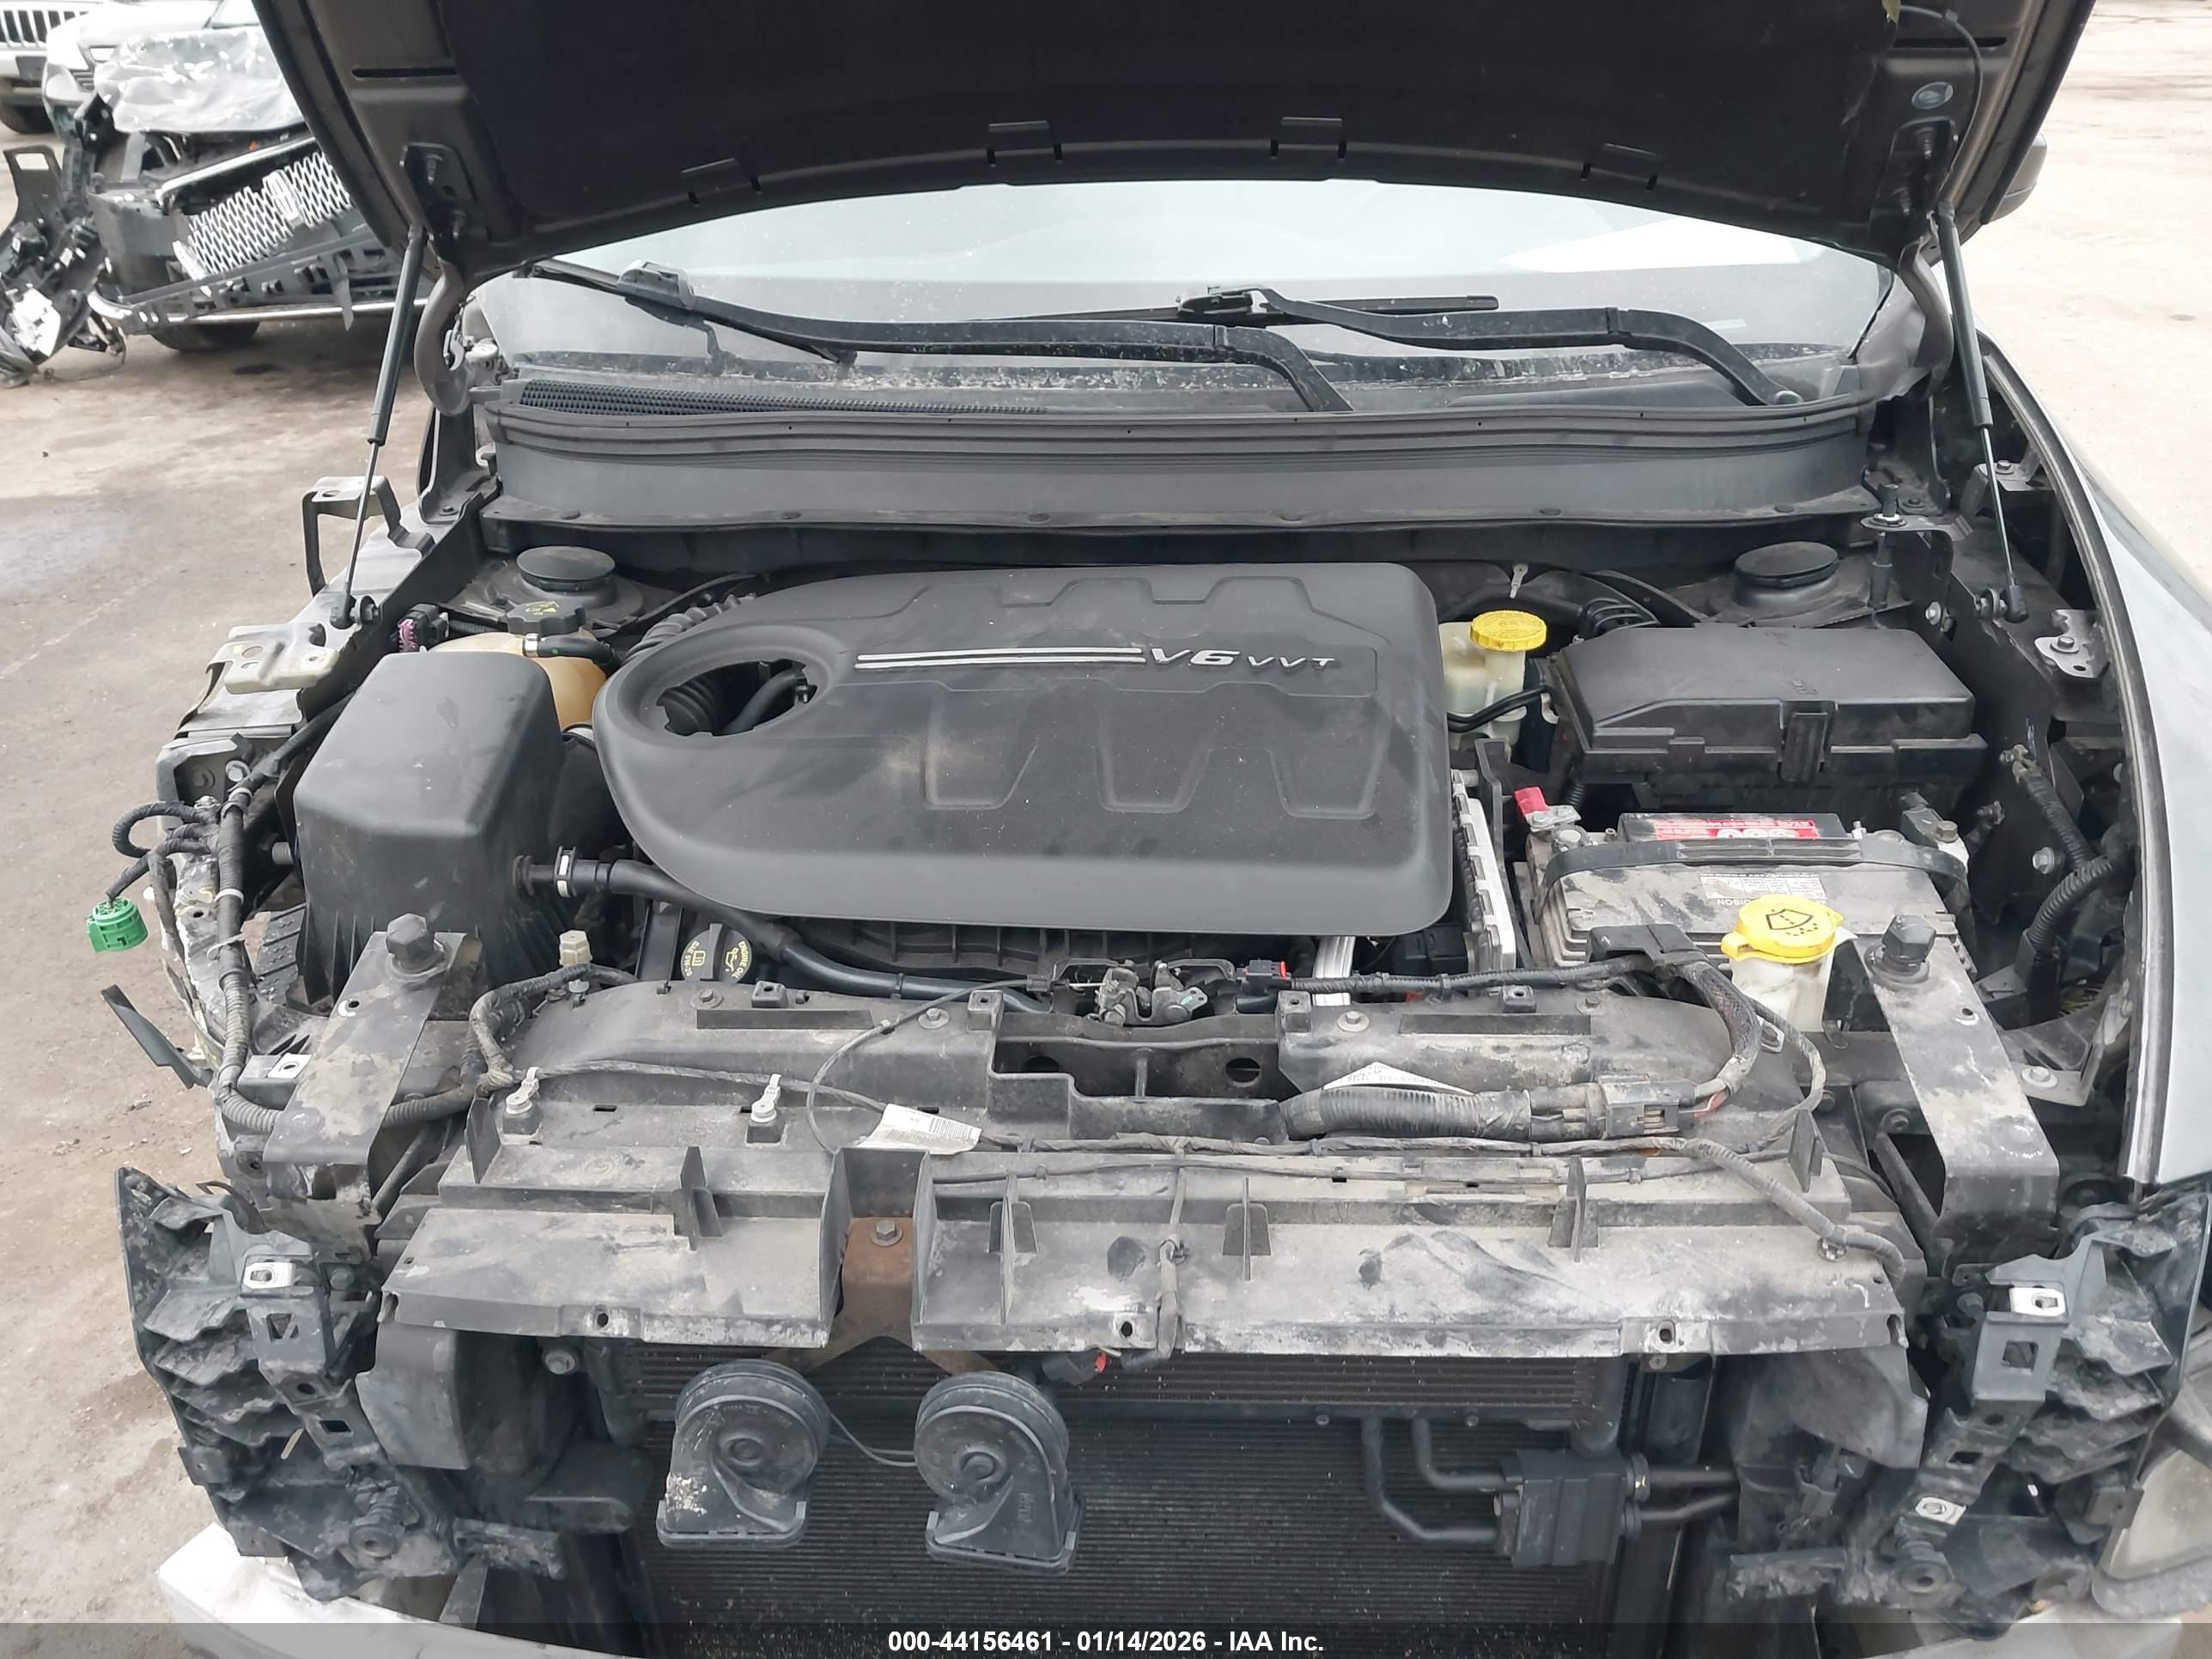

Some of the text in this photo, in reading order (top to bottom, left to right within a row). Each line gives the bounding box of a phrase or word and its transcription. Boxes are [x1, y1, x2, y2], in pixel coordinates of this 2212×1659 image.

[1152, 647, 1336, 667] V6 VVT
[731, 940, 750, 979] ENGINE OIL
